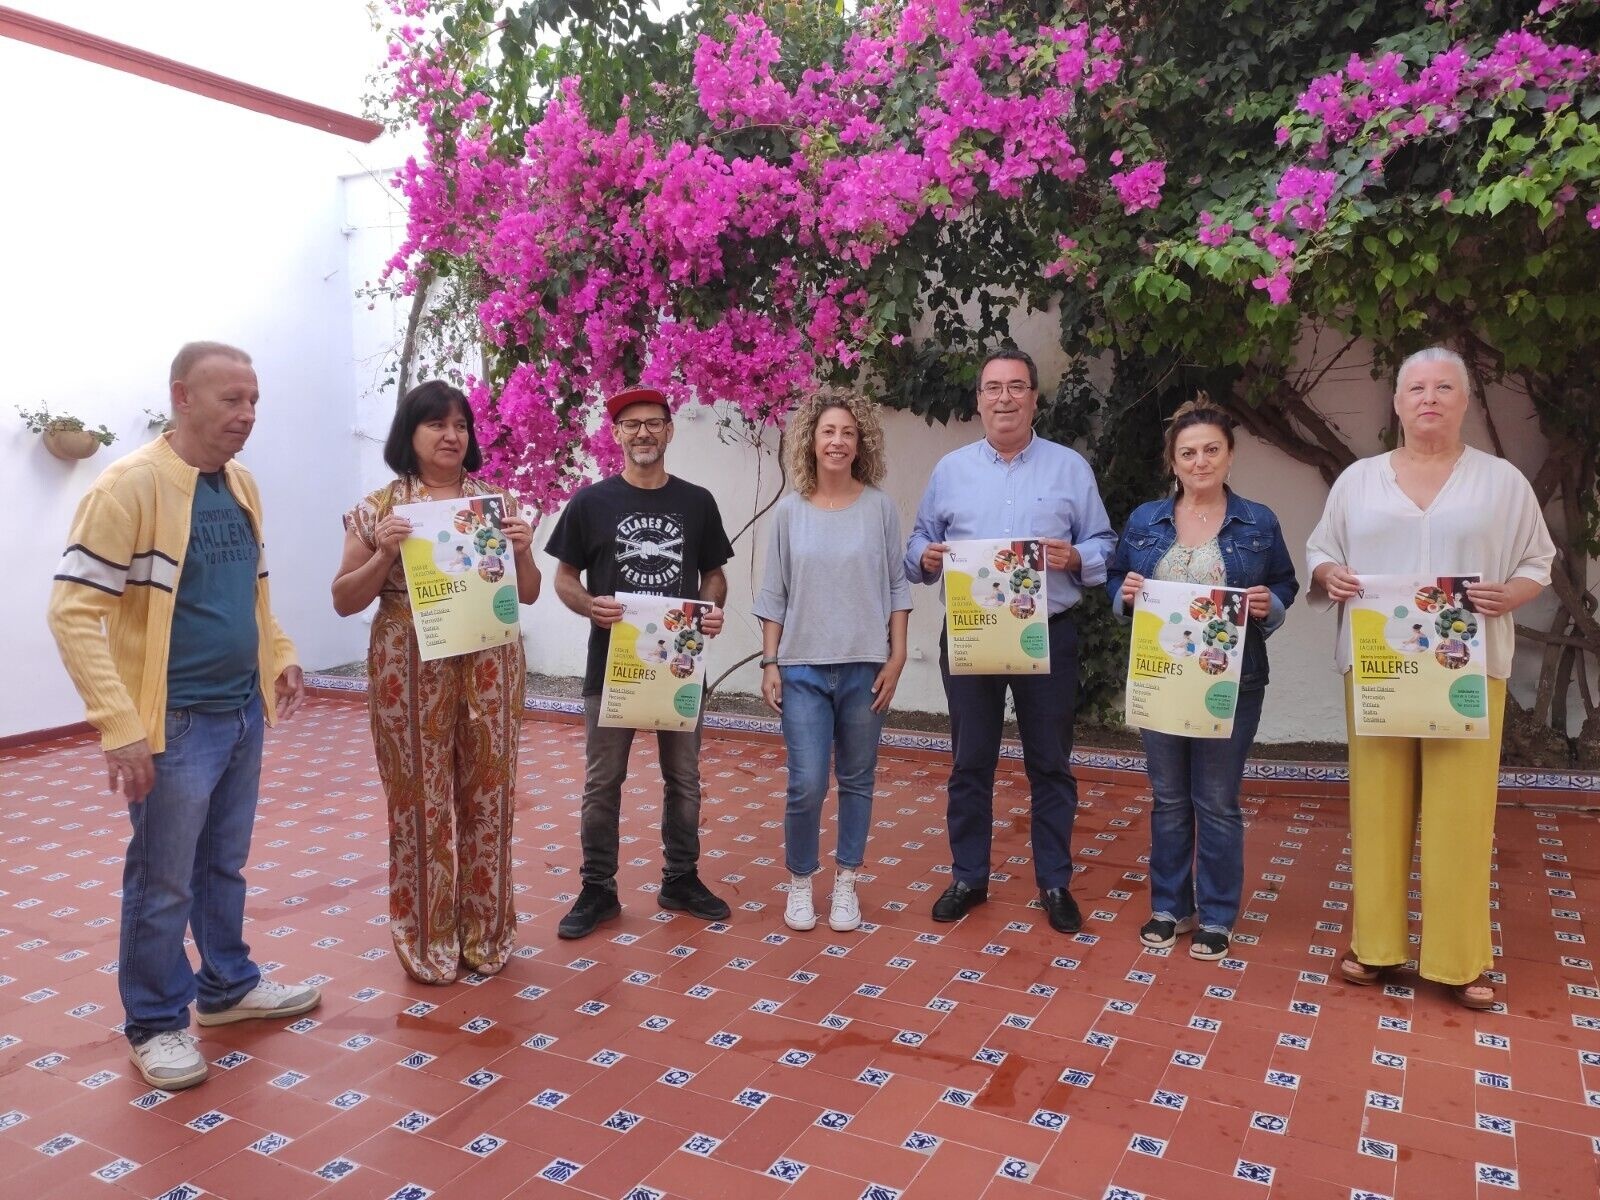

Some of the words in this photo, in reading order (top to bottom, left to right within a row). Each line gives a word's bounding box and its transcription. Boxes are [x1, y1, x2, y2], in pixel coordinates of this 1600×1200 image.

[620, 518, 662, 535] CLASES
[664, 522, 680, 537] DE
[416, 580, 467, 599] TALLERES
[953, 614, 998, 626] TALLERES
[612, 666, 656, 680] TALLERES
[1136, 658, 1183, 676] TALLERES
[1361, 660, 1419, 674] TALLERES
